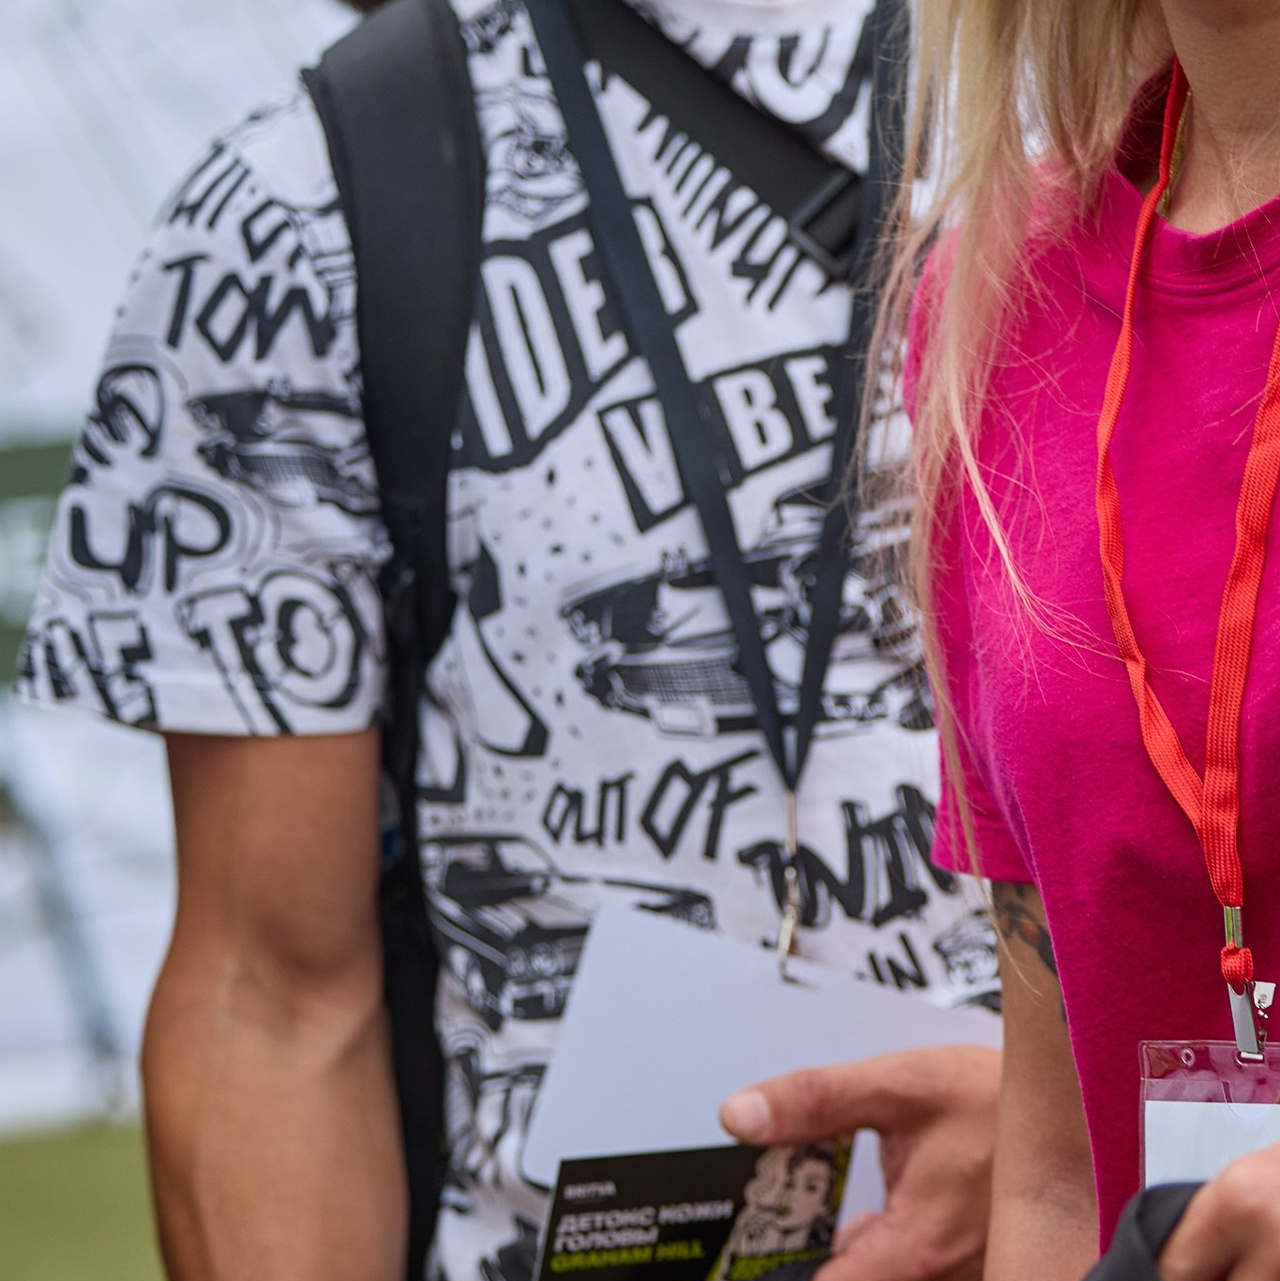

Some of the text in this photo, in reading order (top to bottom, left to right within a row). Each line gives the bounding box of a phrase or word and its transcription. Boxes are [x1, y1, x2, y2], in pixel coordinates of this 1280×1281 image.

[555, 1198, 735, 1235] ДЕТОКС КОЖИ
[553, 1224, 660, 1253] ГОЛОВЫ
